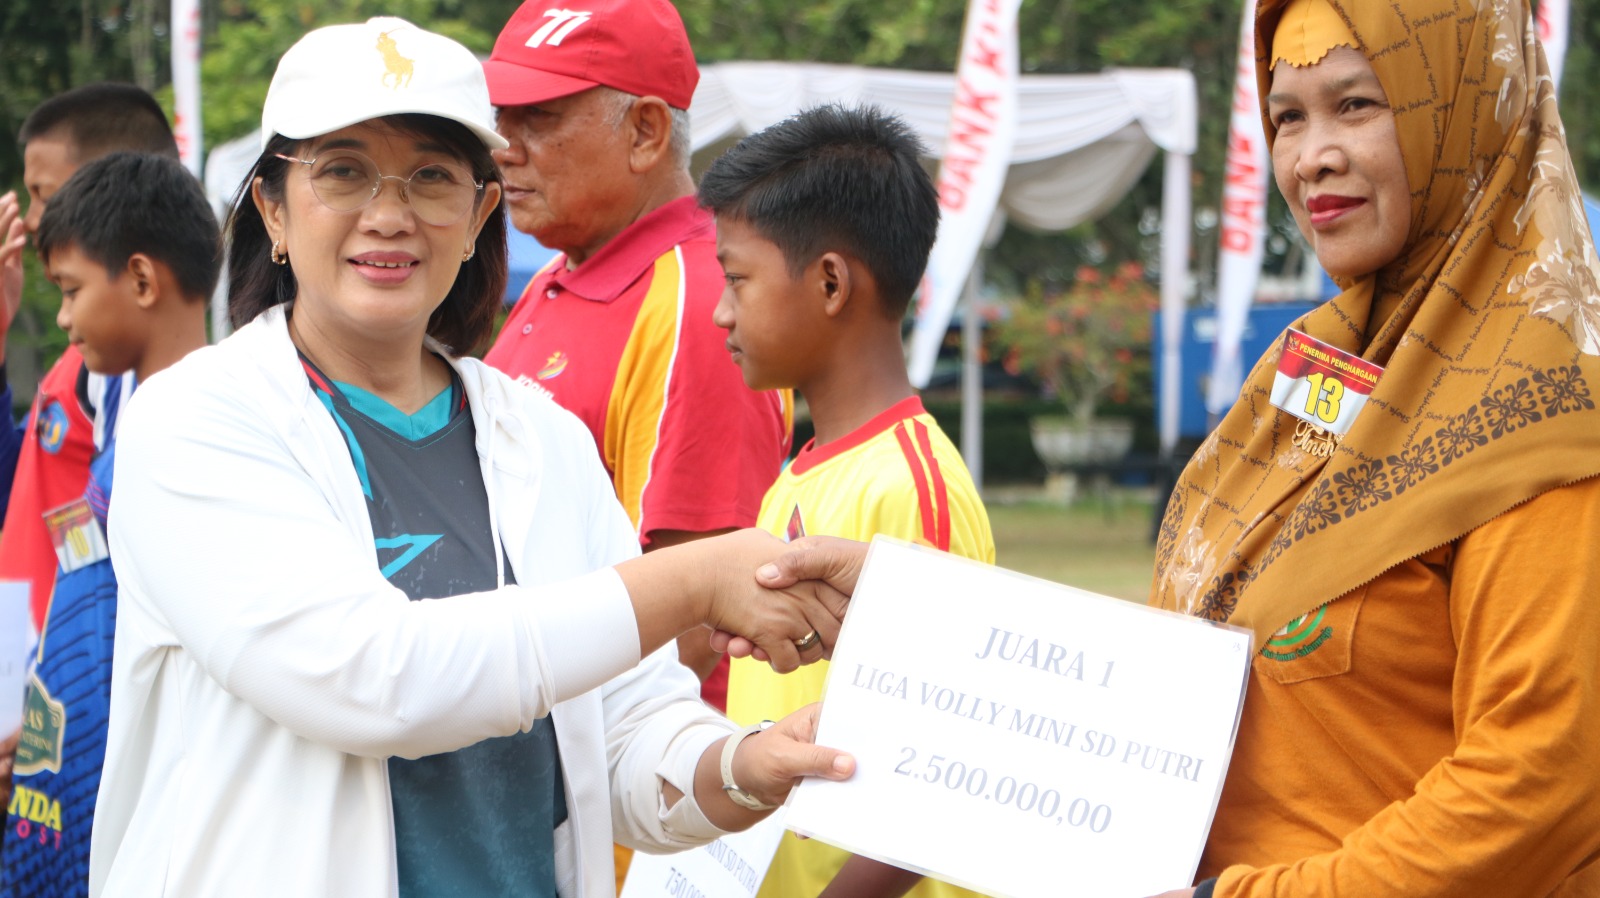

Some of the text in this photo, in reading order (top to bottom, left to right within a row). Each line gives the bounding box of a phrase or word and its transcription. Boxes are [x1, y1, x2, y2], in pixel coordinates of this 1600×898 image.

[1299, 343, 1378, 384] PENERIMA PENGHARGAAN
[1304, 372, 1344, 424] 13
[974, 626, 1117, 689] JUARA 1
[851, 663, 1205, 783] LIGA VOLLY MINI SD PUTRI
[894, 746, 1113, 834] 2.500.000,00
